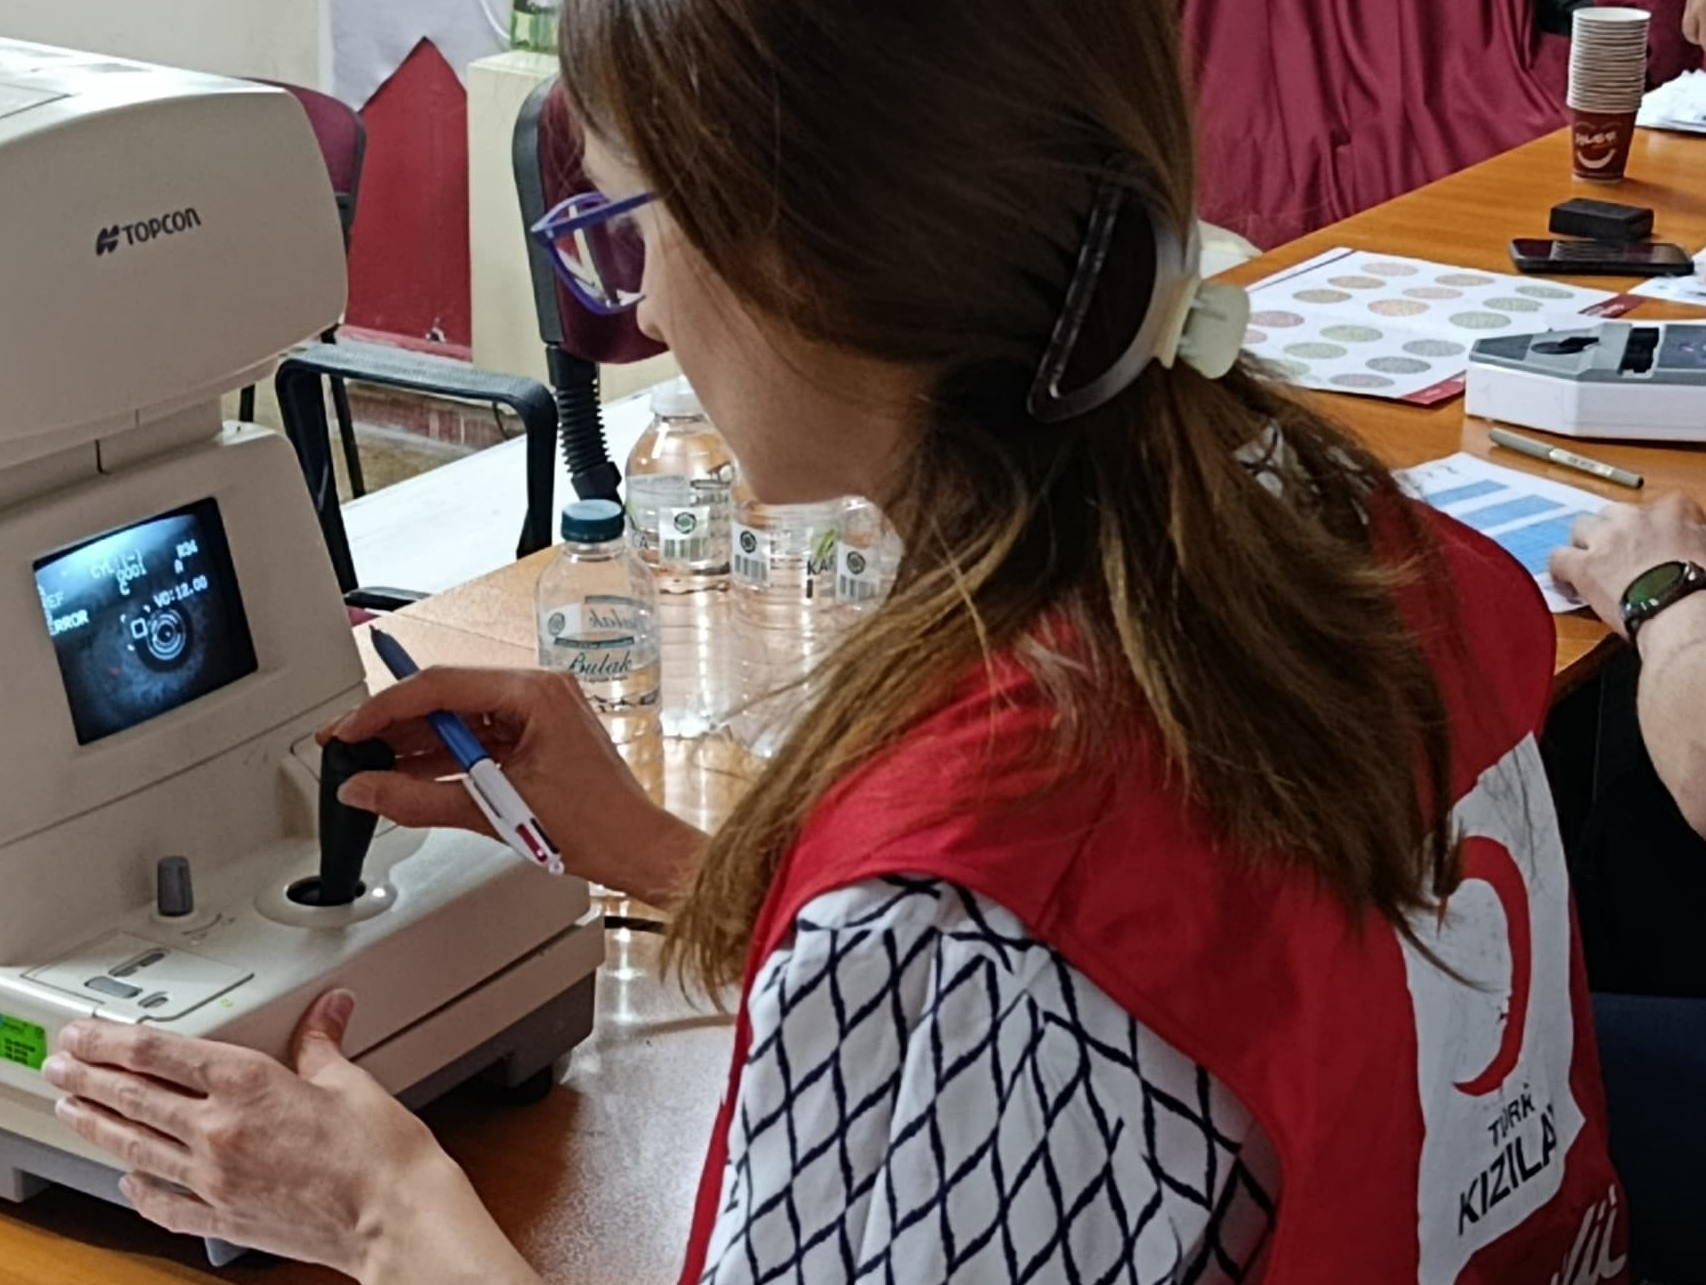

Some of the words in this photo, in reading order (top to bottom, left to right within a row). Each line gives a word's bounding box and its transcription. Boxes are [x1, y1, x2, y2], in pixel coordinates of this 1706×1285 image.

[122, 207, 202, 246] TOPCON
[568, 650, 633, 676] Bulak
[1458, 1103, 1557, 1237] KIZILA
